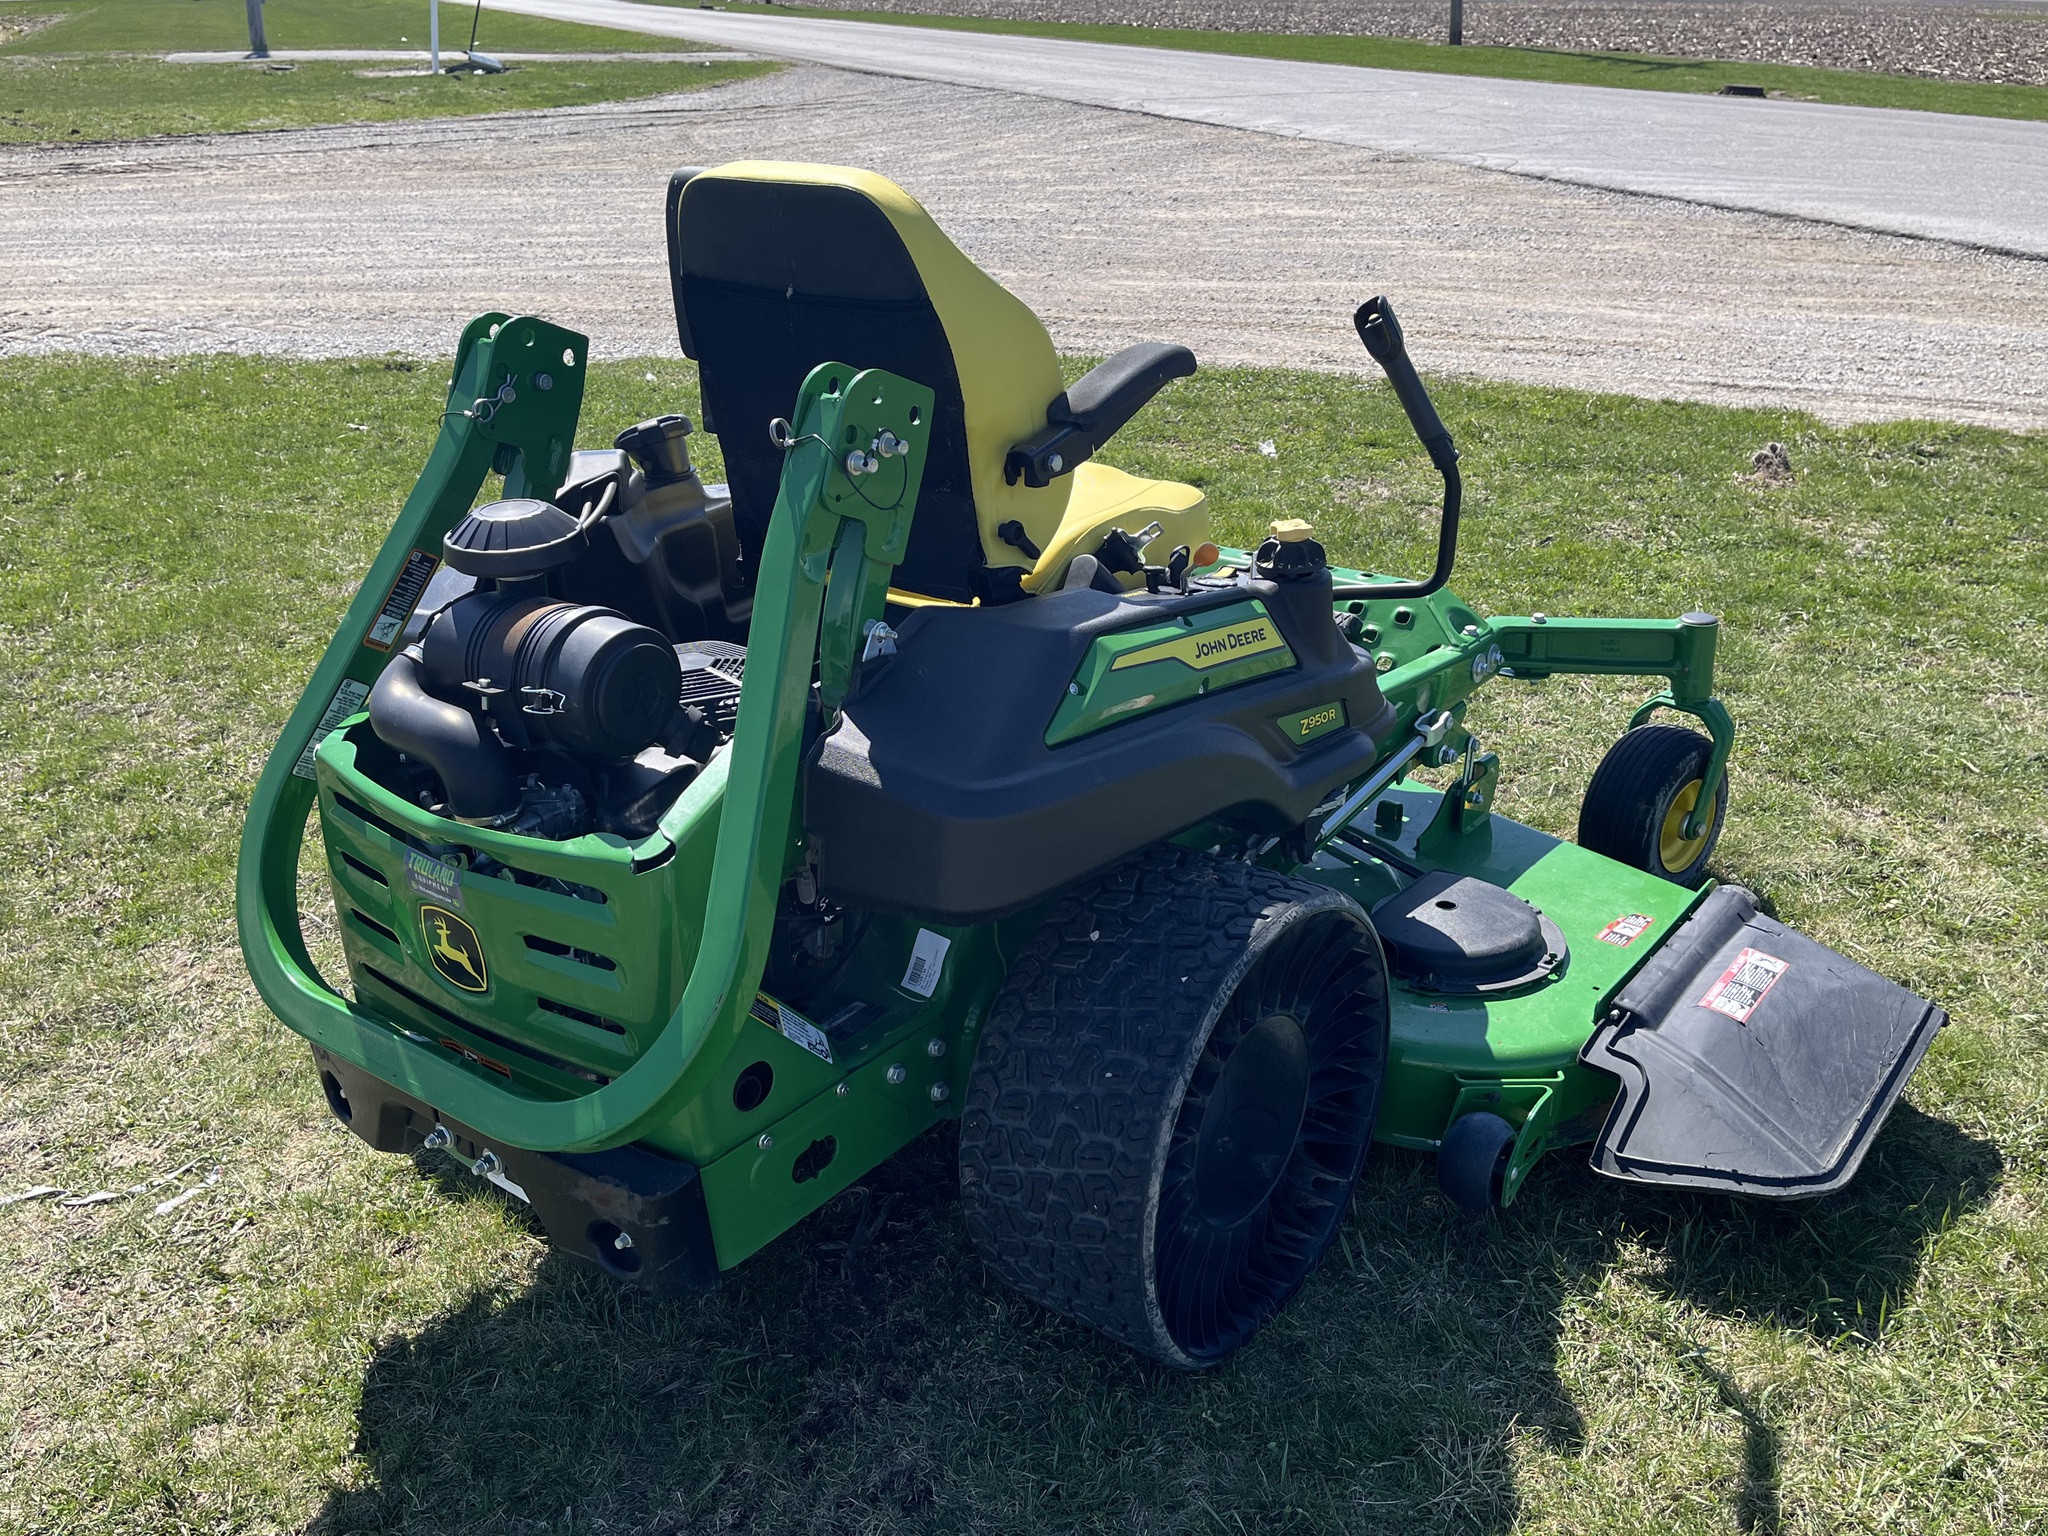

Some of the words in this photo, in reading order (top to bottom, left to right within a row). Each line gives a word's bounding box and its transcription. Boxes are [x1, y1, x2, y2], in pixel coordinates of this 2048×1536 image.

[1195, 638, 1227, 659] JOHN
[1227, 628, 1267, 650] DEERE
[1300, 708, 1336, 736] Z950R
[408, 852, 455, 886] TRULAND
